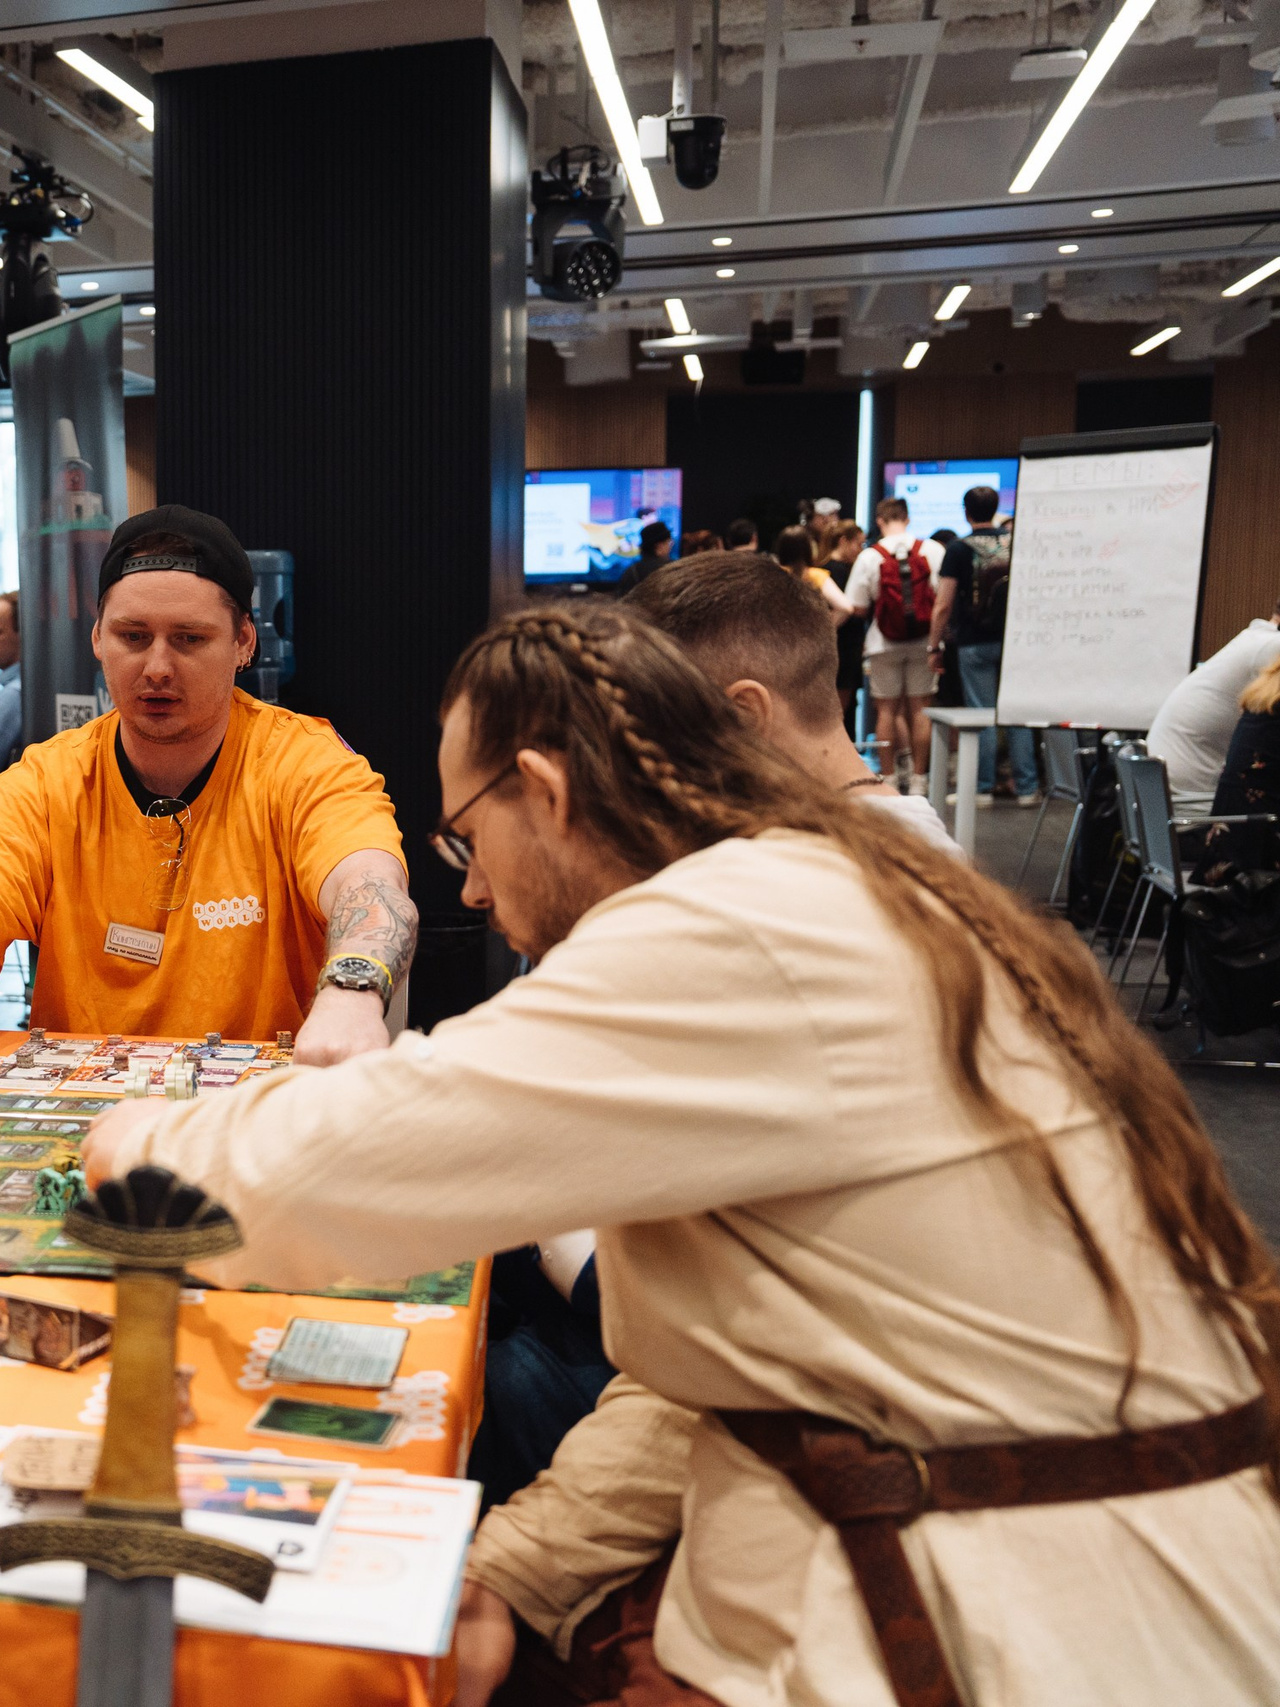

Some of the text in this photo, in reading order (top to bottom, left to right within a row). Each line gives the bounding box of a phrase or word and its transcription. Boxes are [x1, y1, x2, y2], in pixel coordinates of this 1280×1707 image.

[1047, 460, 1154, 484] ТЕМЫ:
[193, 899, 255, 916] HOBBY
[201, 910, 264, 927] WORLD
